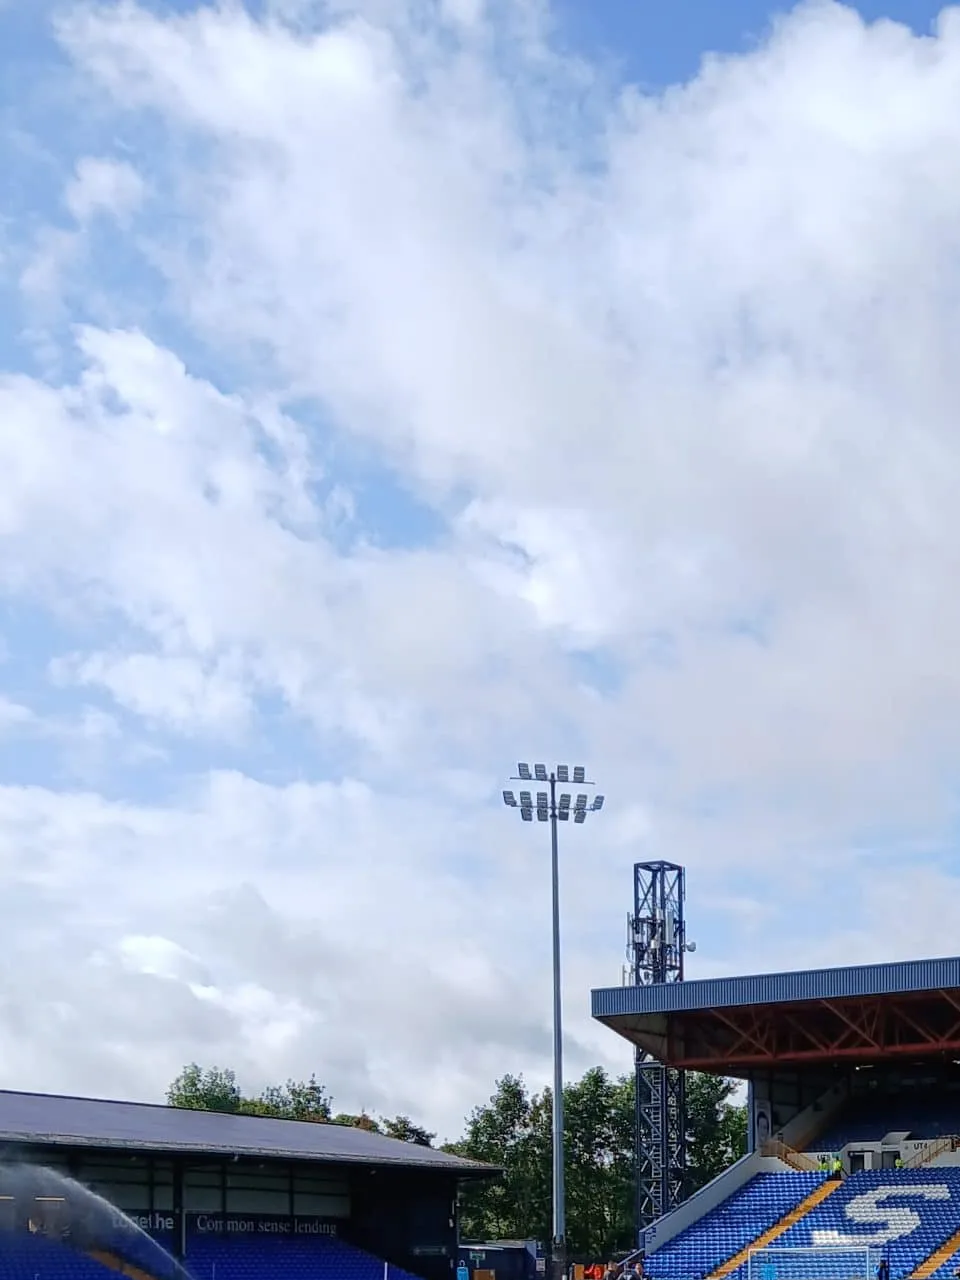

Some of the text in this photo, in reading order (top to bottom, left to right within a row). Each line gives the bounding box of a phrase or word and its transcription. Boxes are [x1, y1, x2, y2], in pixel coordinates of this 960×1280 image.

[197, 1214, 255, 1233] Common
[257, 1217, 290, 1233] sense
[294, 1218, 337, 1236] lending
